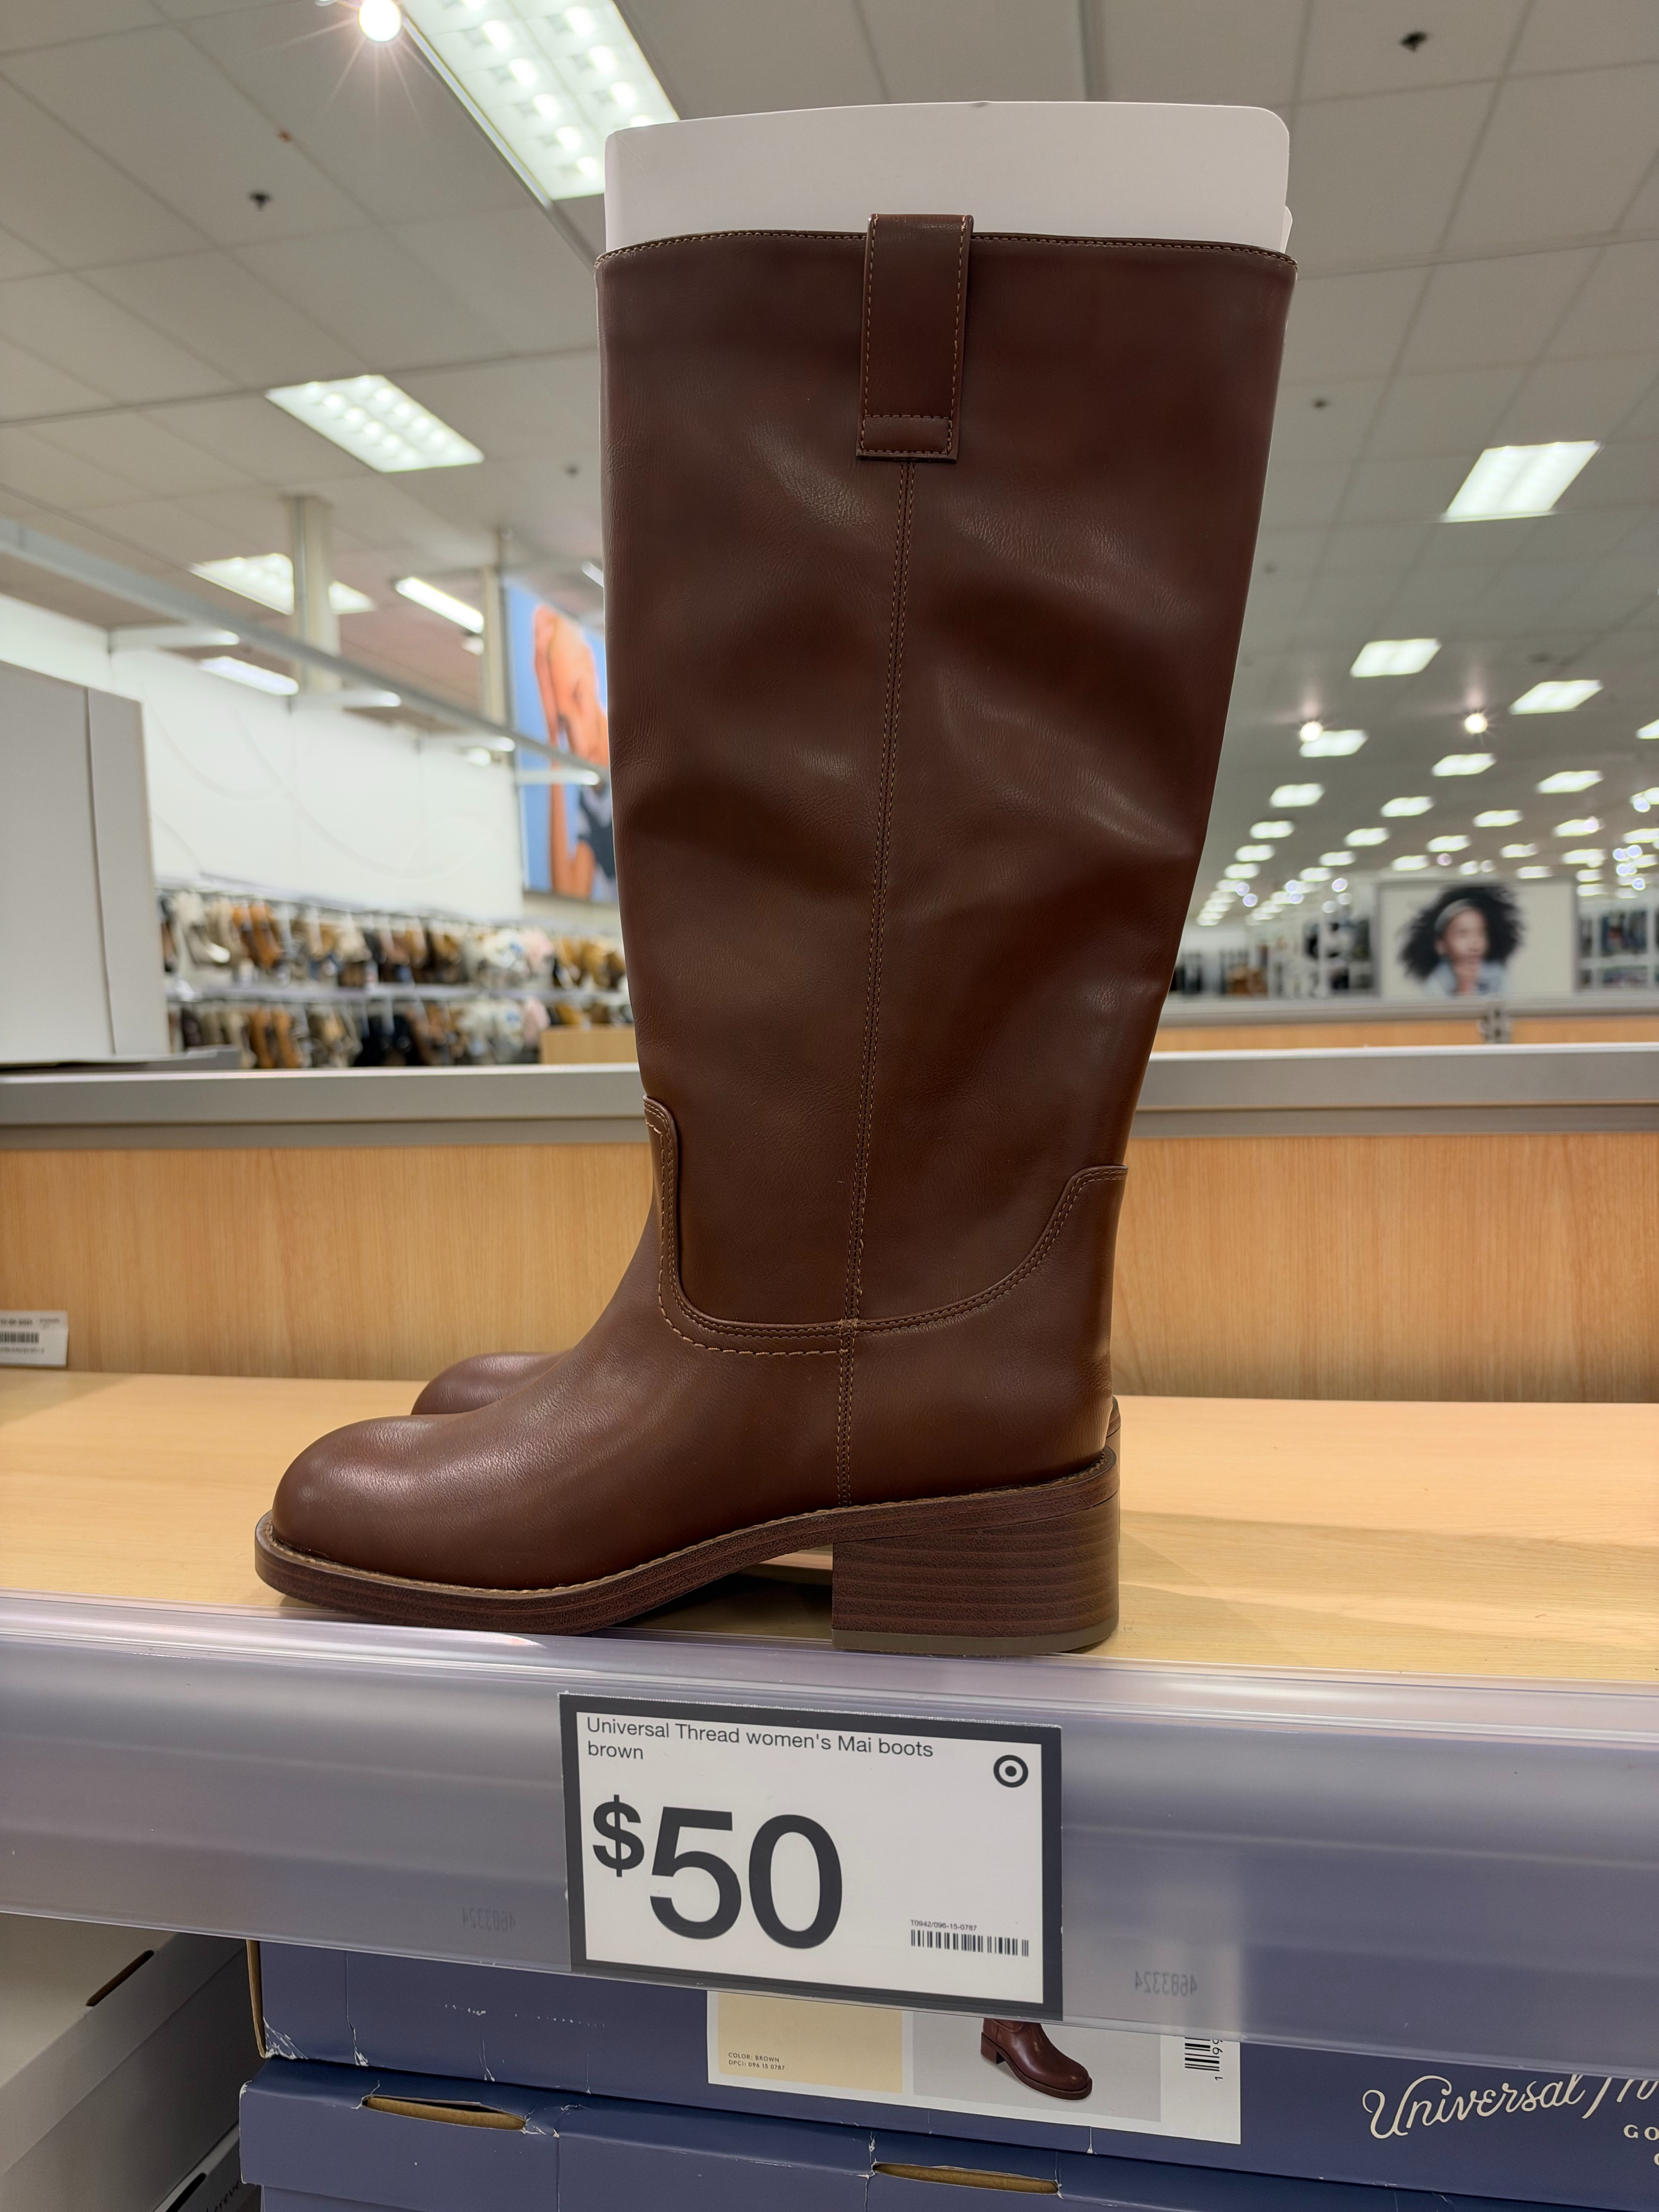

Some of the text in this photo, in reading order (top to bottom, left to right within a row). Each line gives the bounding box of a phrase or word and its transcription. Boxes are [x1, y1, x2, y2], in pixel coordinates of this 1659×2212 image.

[587, 1716, 933, 1757] Universal Thread women's Mai boots
[587, 1740, 643, 1760] brown
[592, 1794, 843, 1949] $50
[1362, 2074, 1586, 2139] Universal
